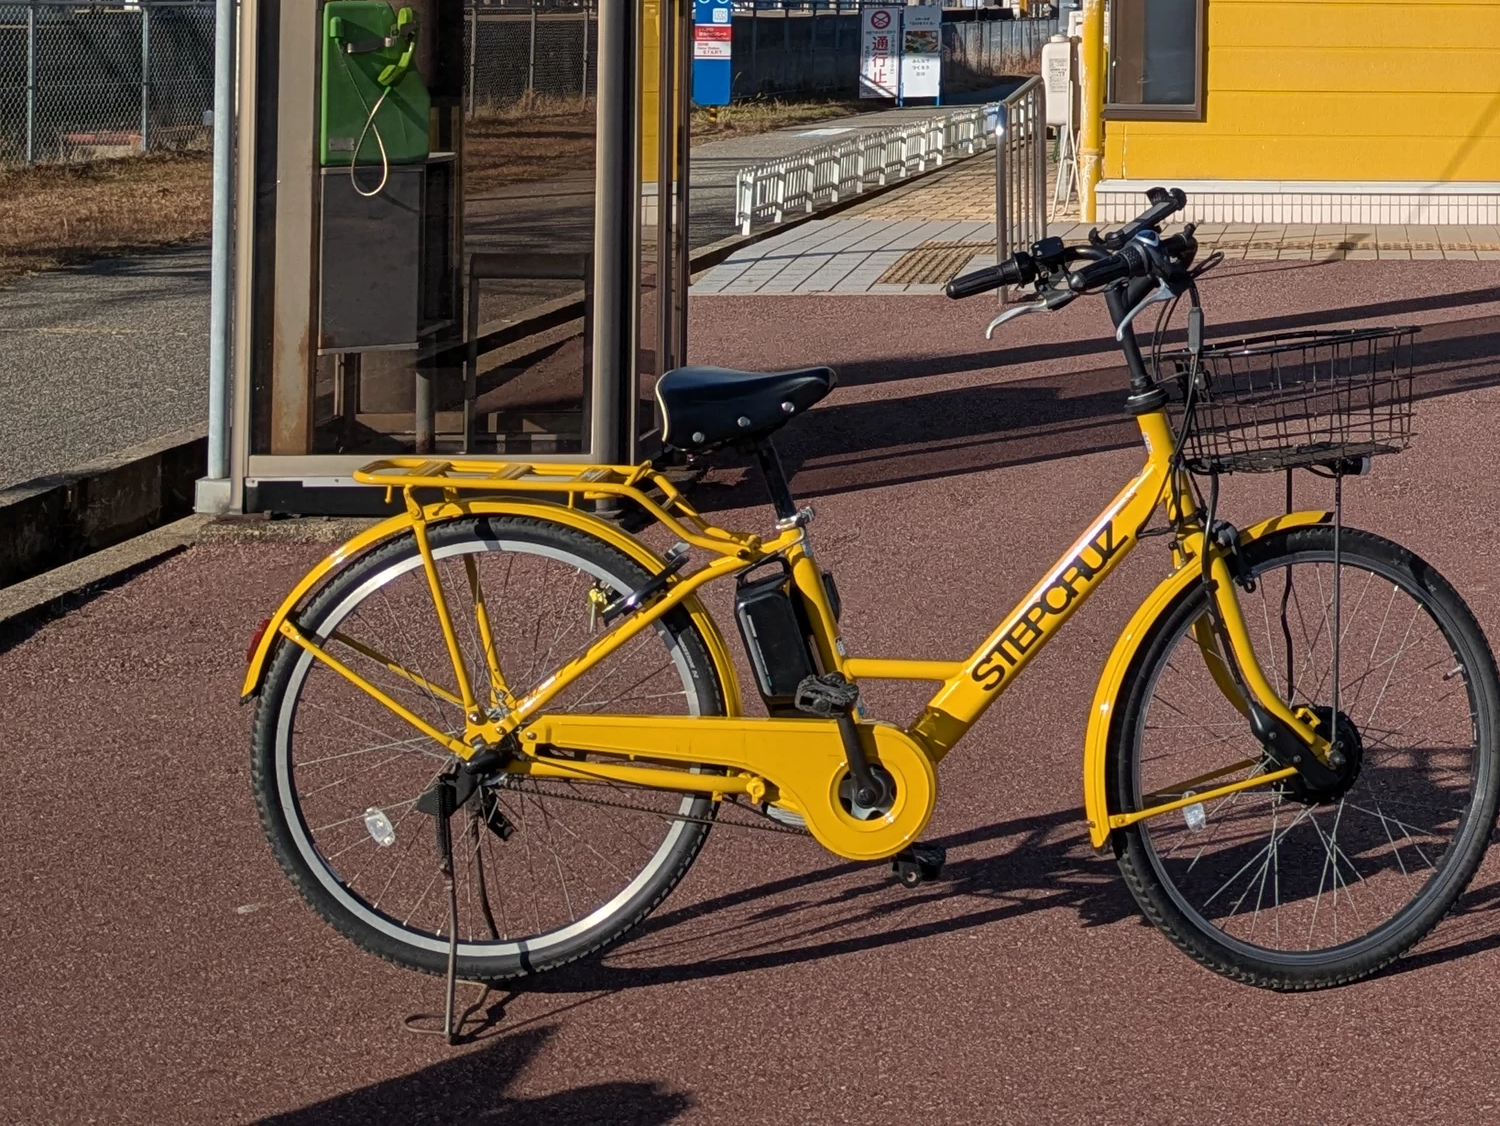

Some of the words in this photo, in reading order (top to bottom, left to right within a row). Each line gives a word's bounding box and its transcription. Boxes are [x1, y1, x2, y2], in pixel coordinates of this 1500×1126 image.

[871, 35, 890, 85] 通行止
[970, 519, 1130, 692] STEPCRUZ
